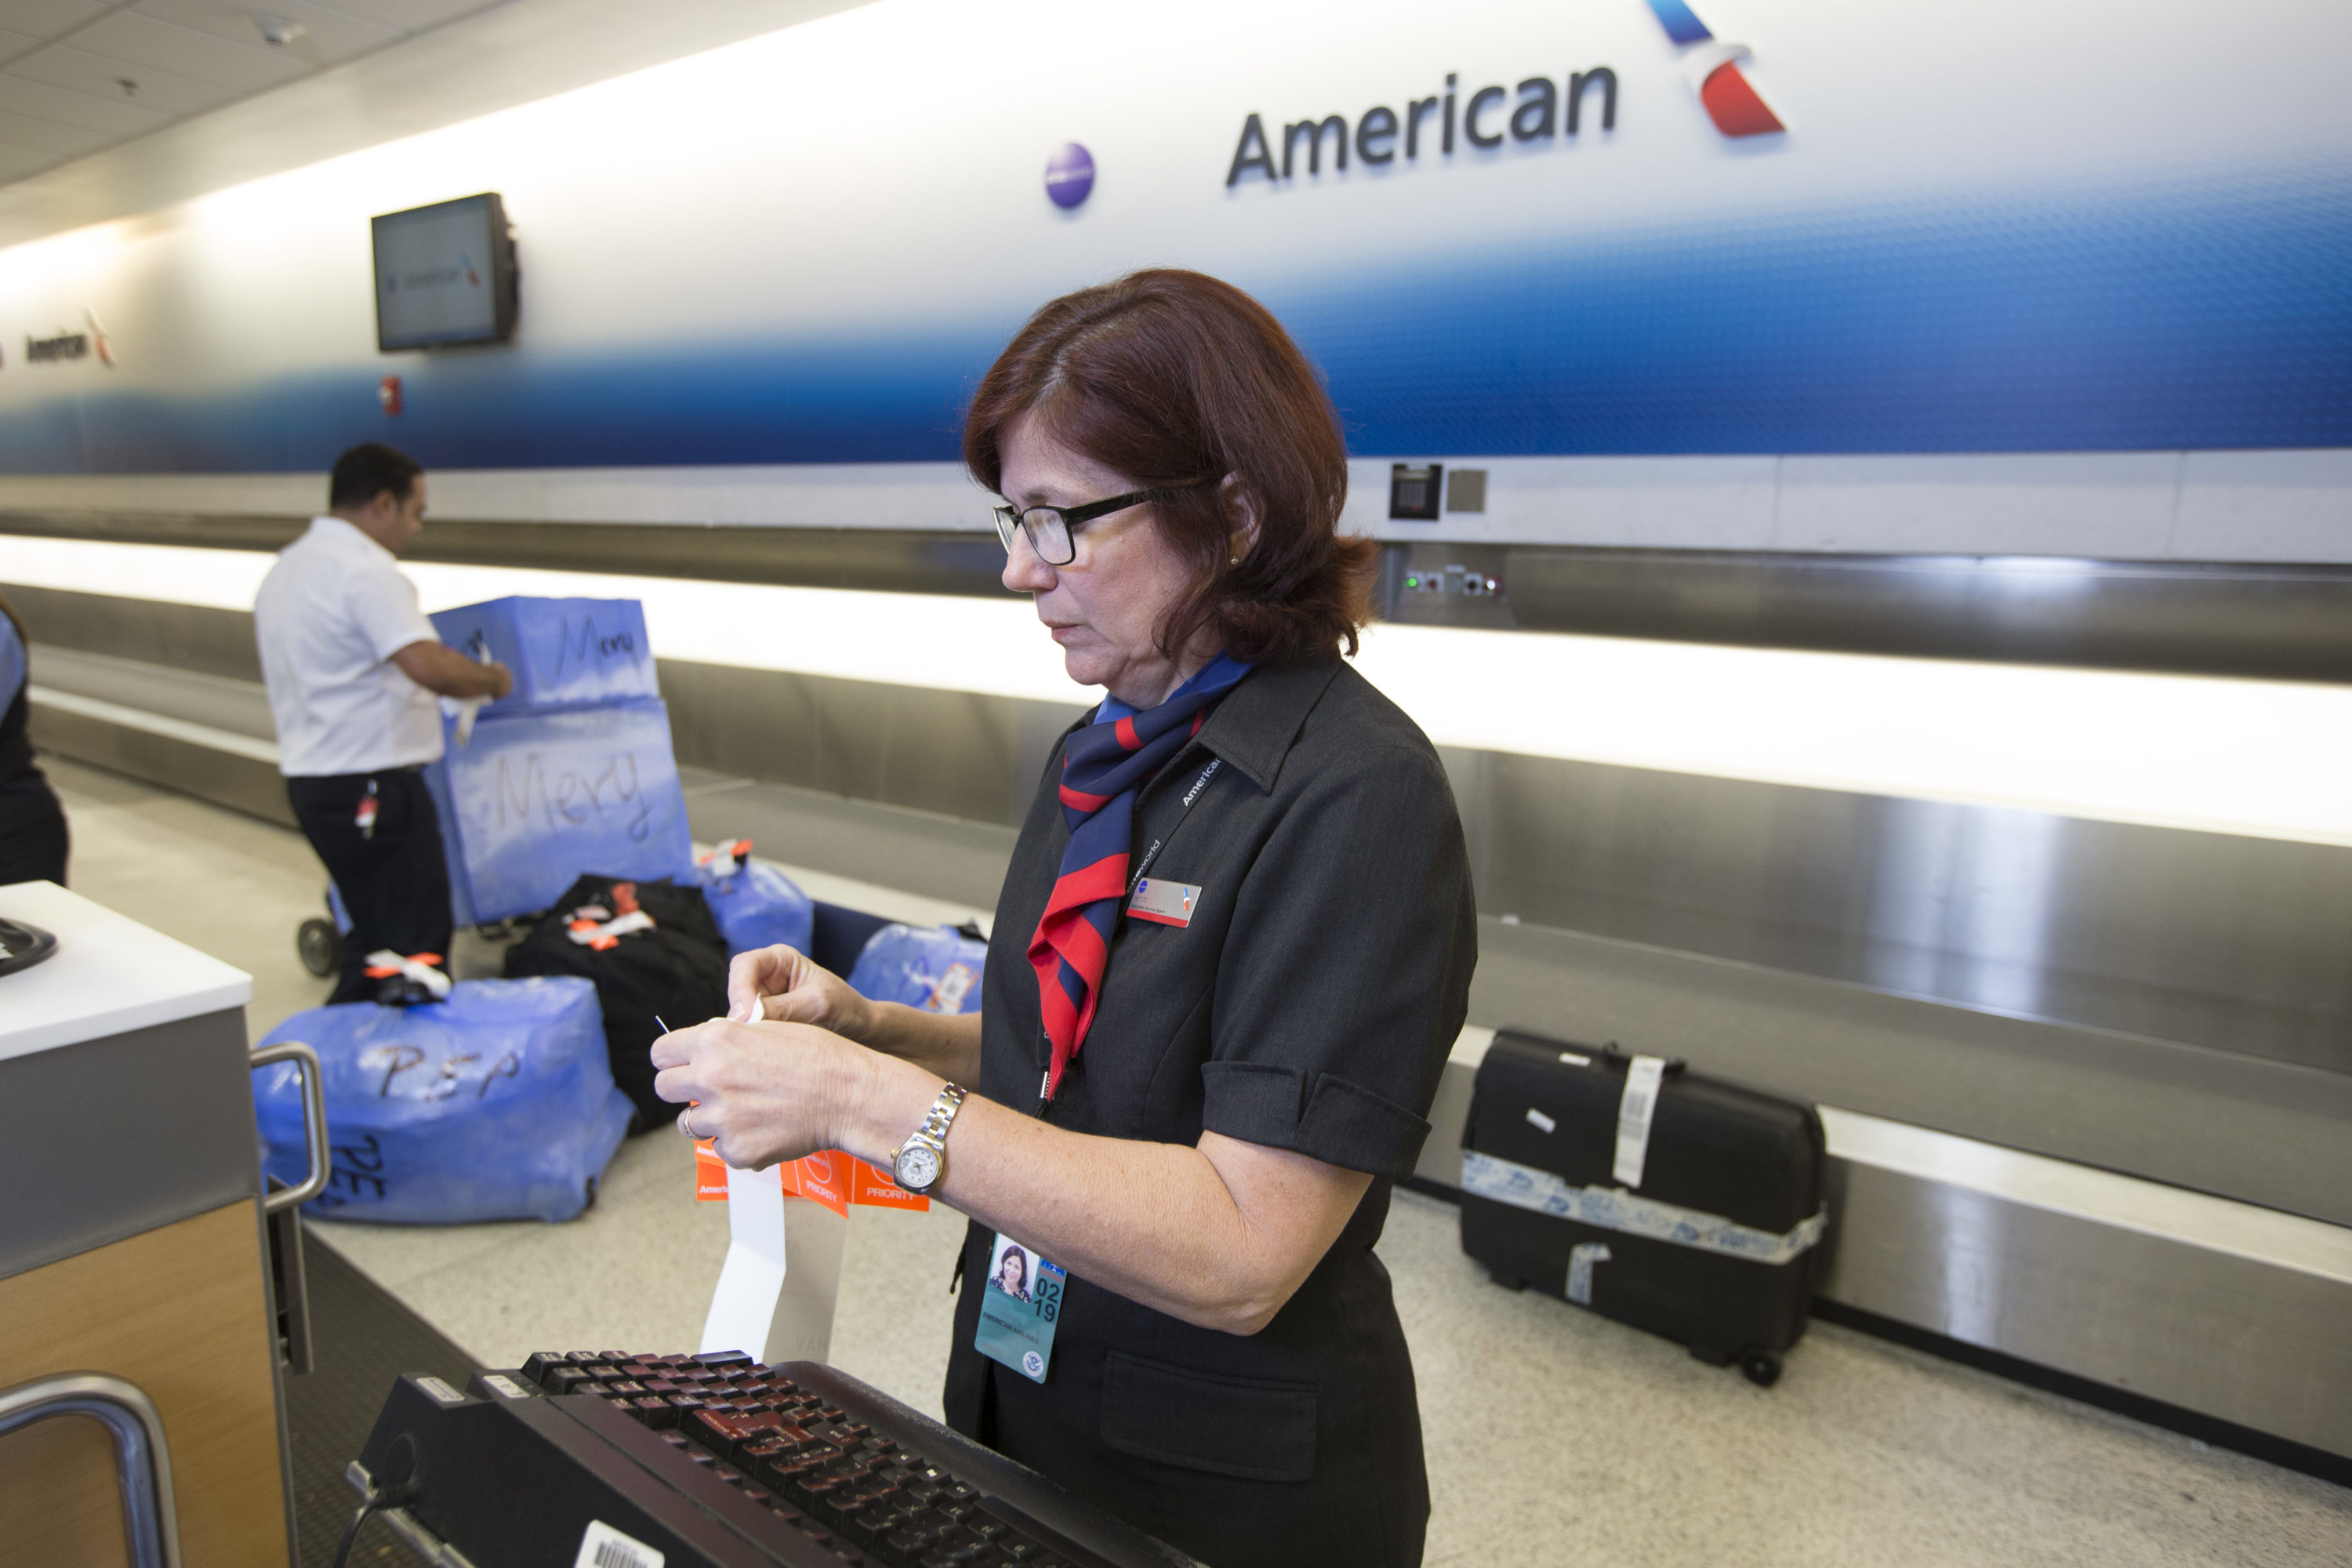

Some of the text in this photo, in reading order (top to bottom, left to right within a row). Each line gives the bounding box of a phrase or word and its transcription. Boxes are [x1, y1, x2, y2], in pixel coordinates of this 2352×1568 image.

[1226, 65, 1618, 189] American
[498, 752, 655, 844] Mery
[806, 1179, 837, 1203] PRIORITY
[866, 1187, 913, 1201] PRIORITY
[1036, 1277, 1060, 1304] 02
[1034, 1298, 1056, 1323] 19
[983, 1312, 1040, 1345] AMERICAN AIRLINES
